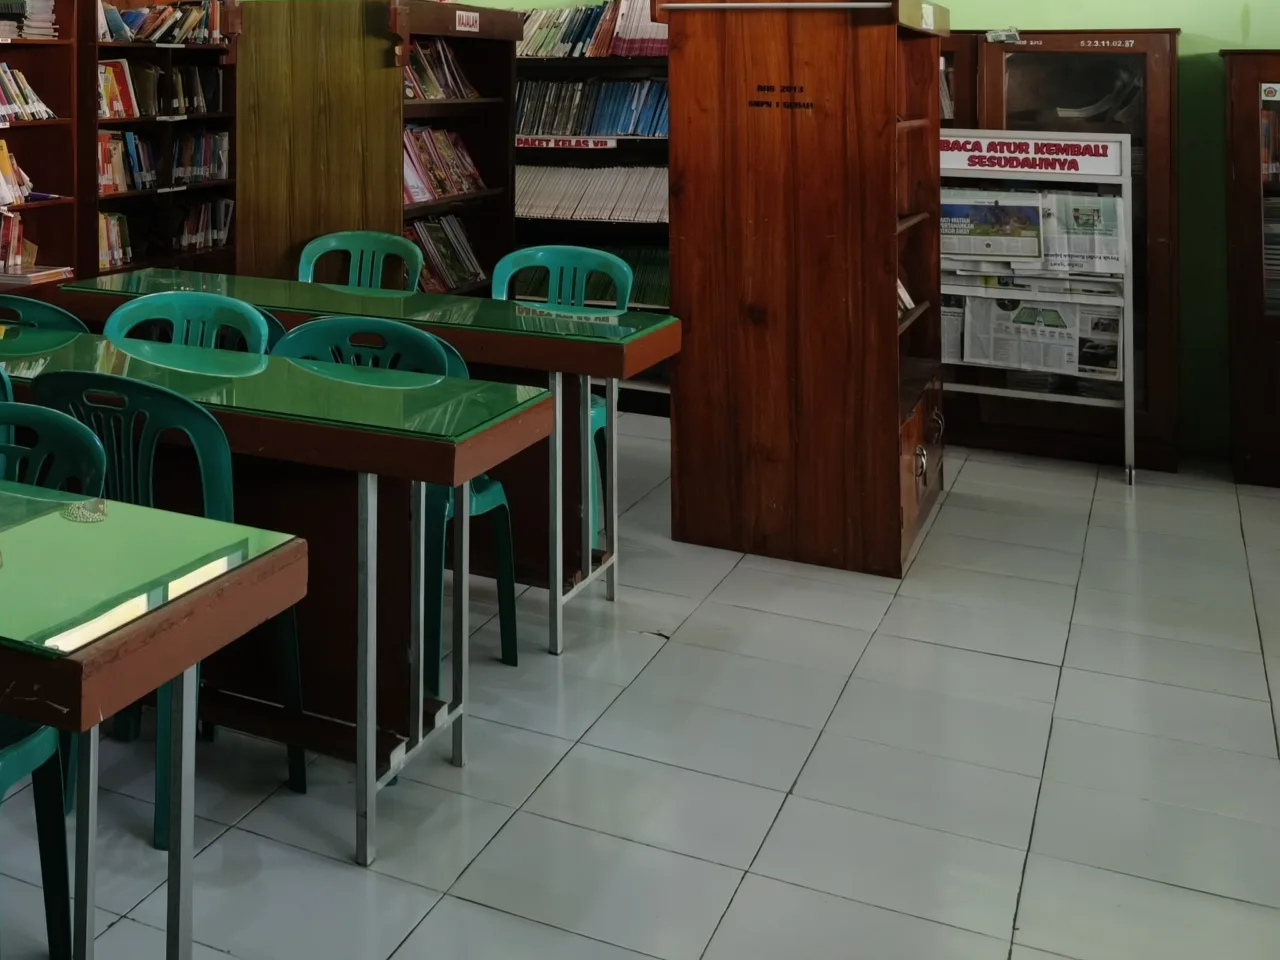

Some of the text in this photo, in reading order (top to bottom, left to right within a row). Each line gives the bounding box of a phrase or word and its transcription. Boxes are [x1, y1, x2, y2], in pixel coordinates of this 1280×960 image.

[516, 138, 551, 147] PAKET
[554, 139, 589, 147] KELAS
[940, 140, 1108, 157] BACA ATUR KEMBALI
[967, 155, 1079, 171] SESUDAHNYA
